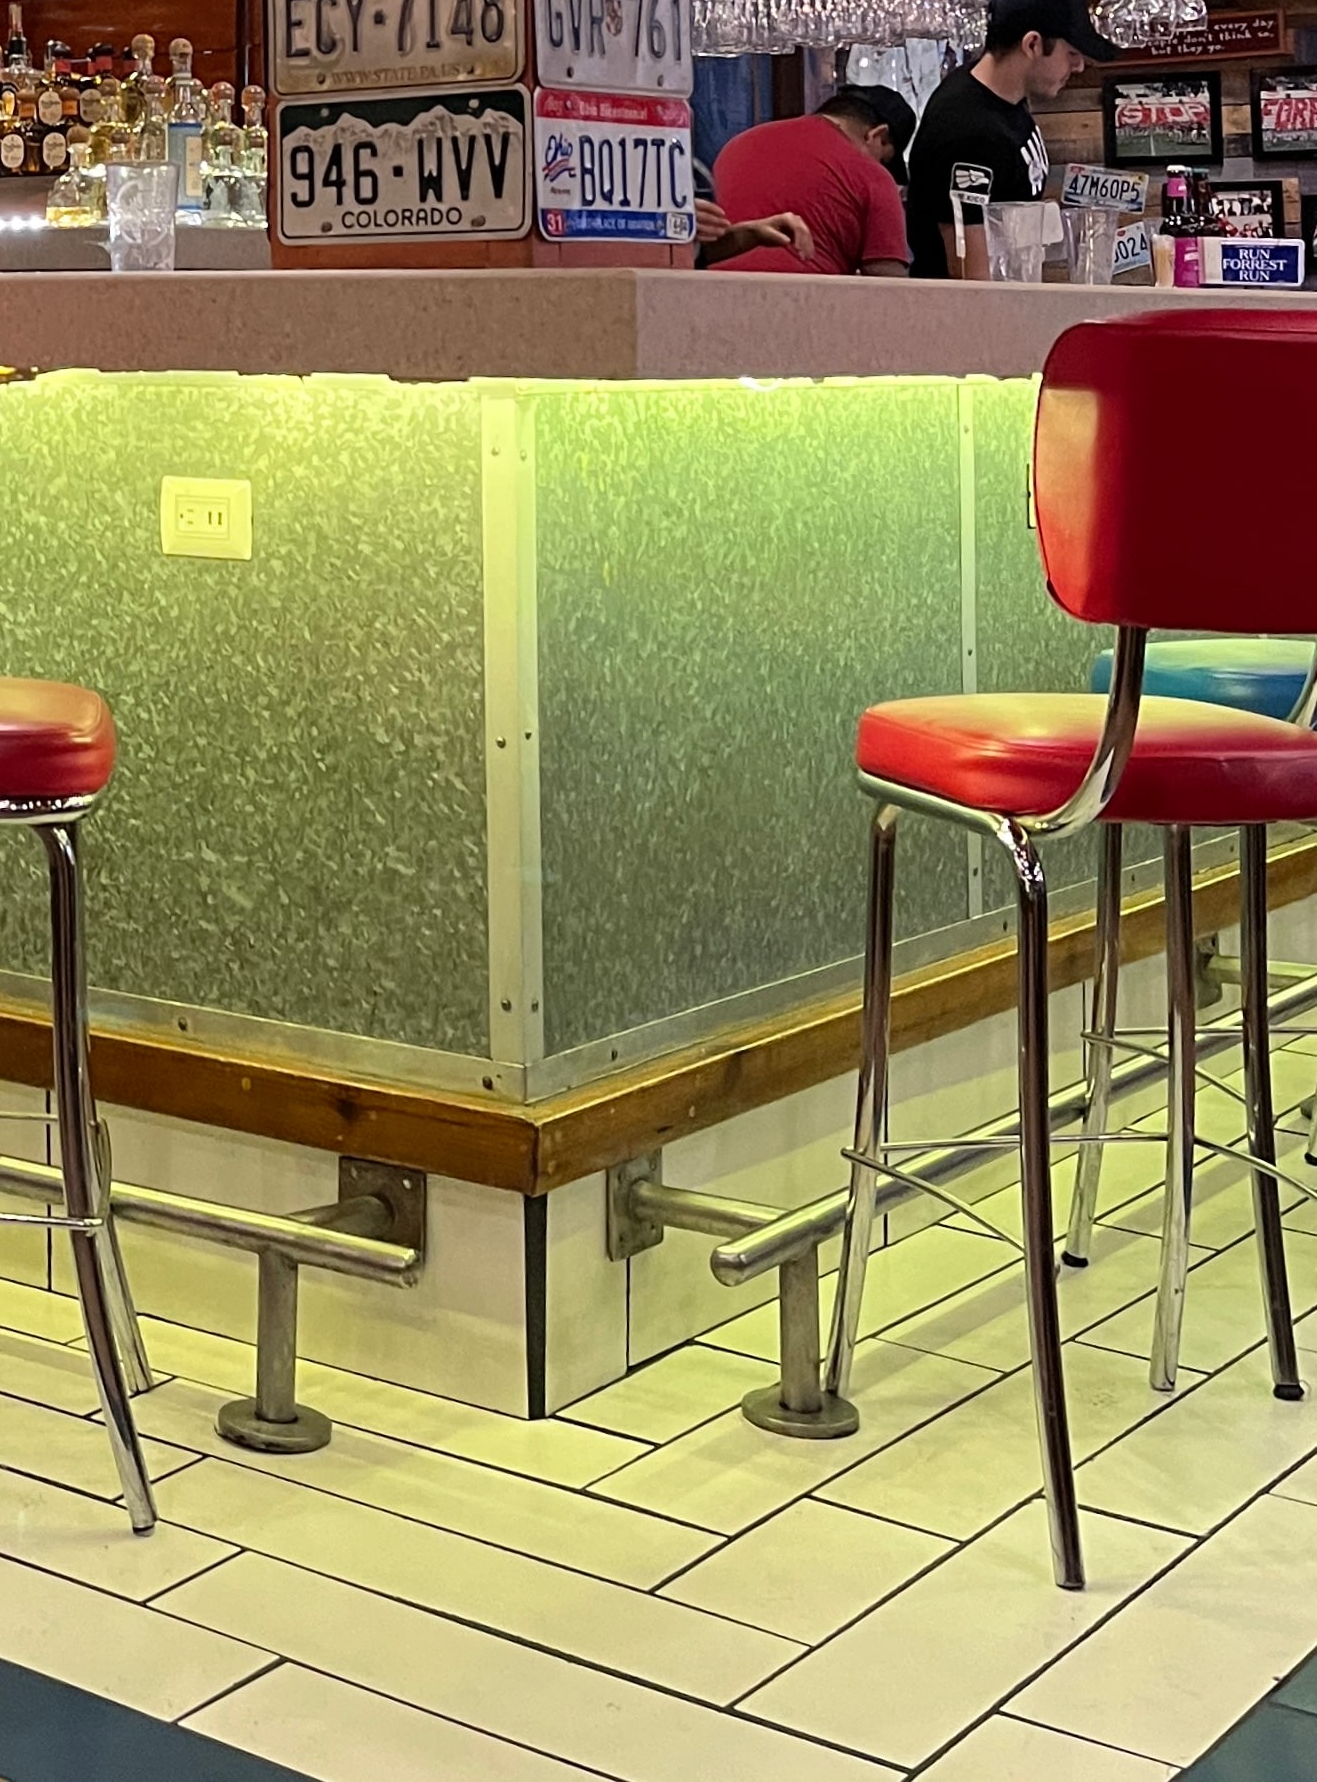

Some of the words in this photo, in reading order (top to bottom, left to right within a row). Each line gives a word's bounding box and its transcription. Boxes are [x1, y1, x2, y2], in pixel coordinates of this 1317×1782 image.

[1214, 21, 1247, 32] every
[1252, 19, 1275, 30] day
[1183, 32, 1214, 44] don't
[1219, 29, 1252, 41] think
[1151, 46, 1172, 56] but
[1177, 43, 1203, 55] they
[342, 207, 462, 229] COLORADO
[1239, 248, 1271, 260] RUN
[1223, 259, 1287, 272] FORREST
[1239, 270, 1271, 282] RUN
